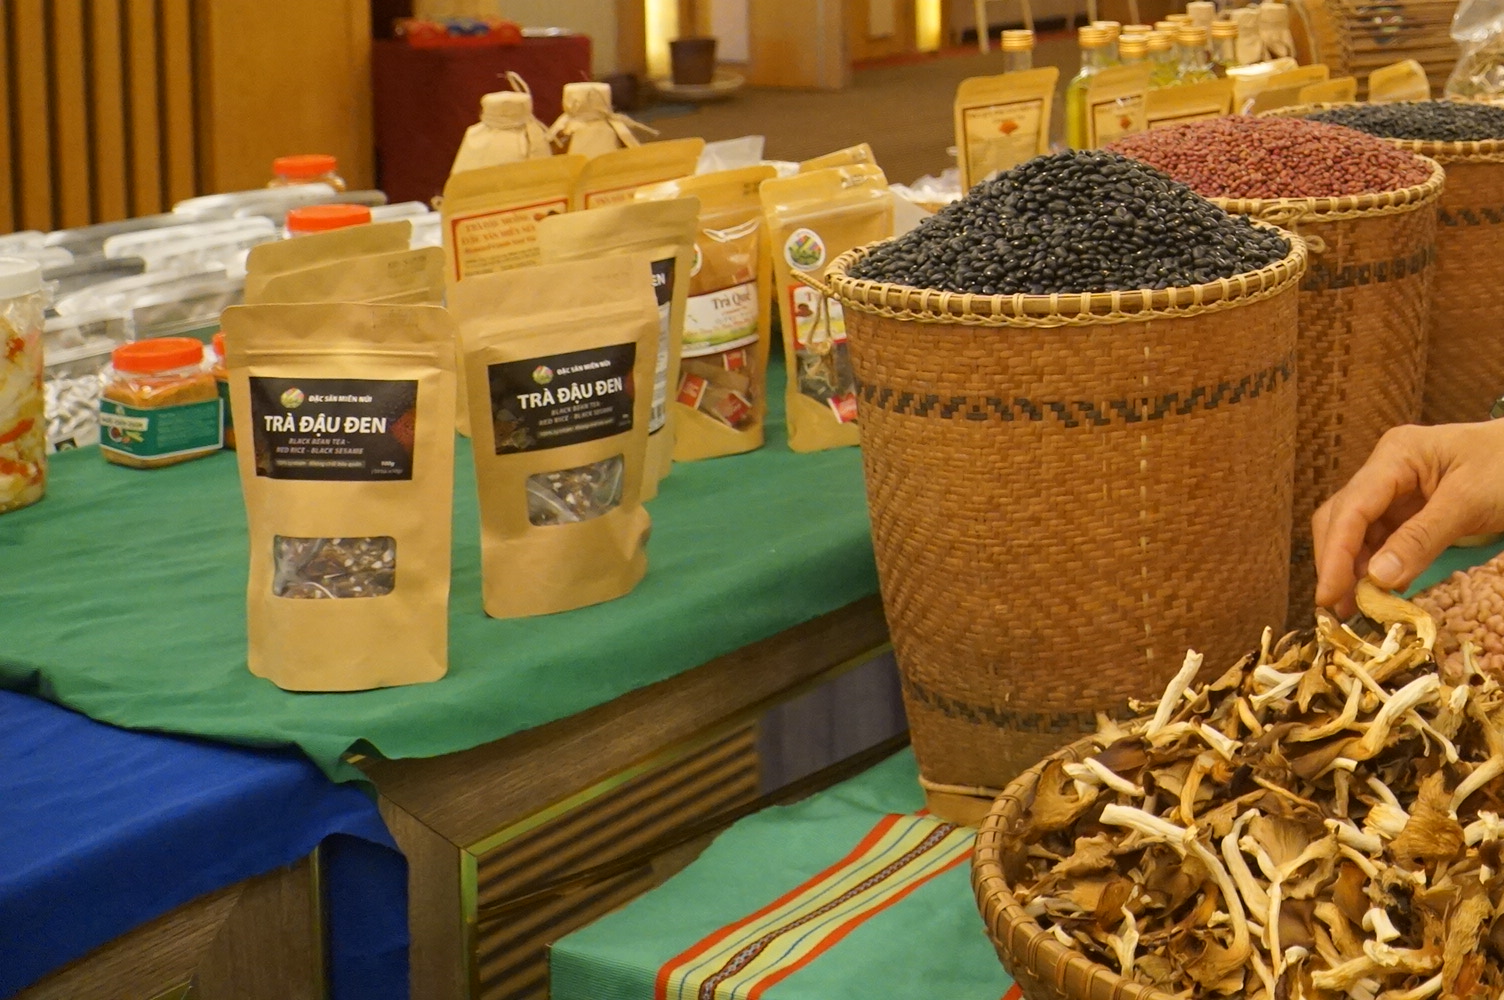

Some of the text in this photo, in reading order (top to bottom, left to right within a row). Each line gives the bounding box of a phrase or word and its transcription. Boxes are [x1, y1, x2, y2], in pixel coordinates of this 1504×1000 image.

[651, 273, 666, 287] EN
[517, 377, 623, 409] TRÀ ĐẬU ĐEN
[264, 412, 387, 437] TRÀ ĐẬU ĐEN
[276, 446, 290, 454] RED
